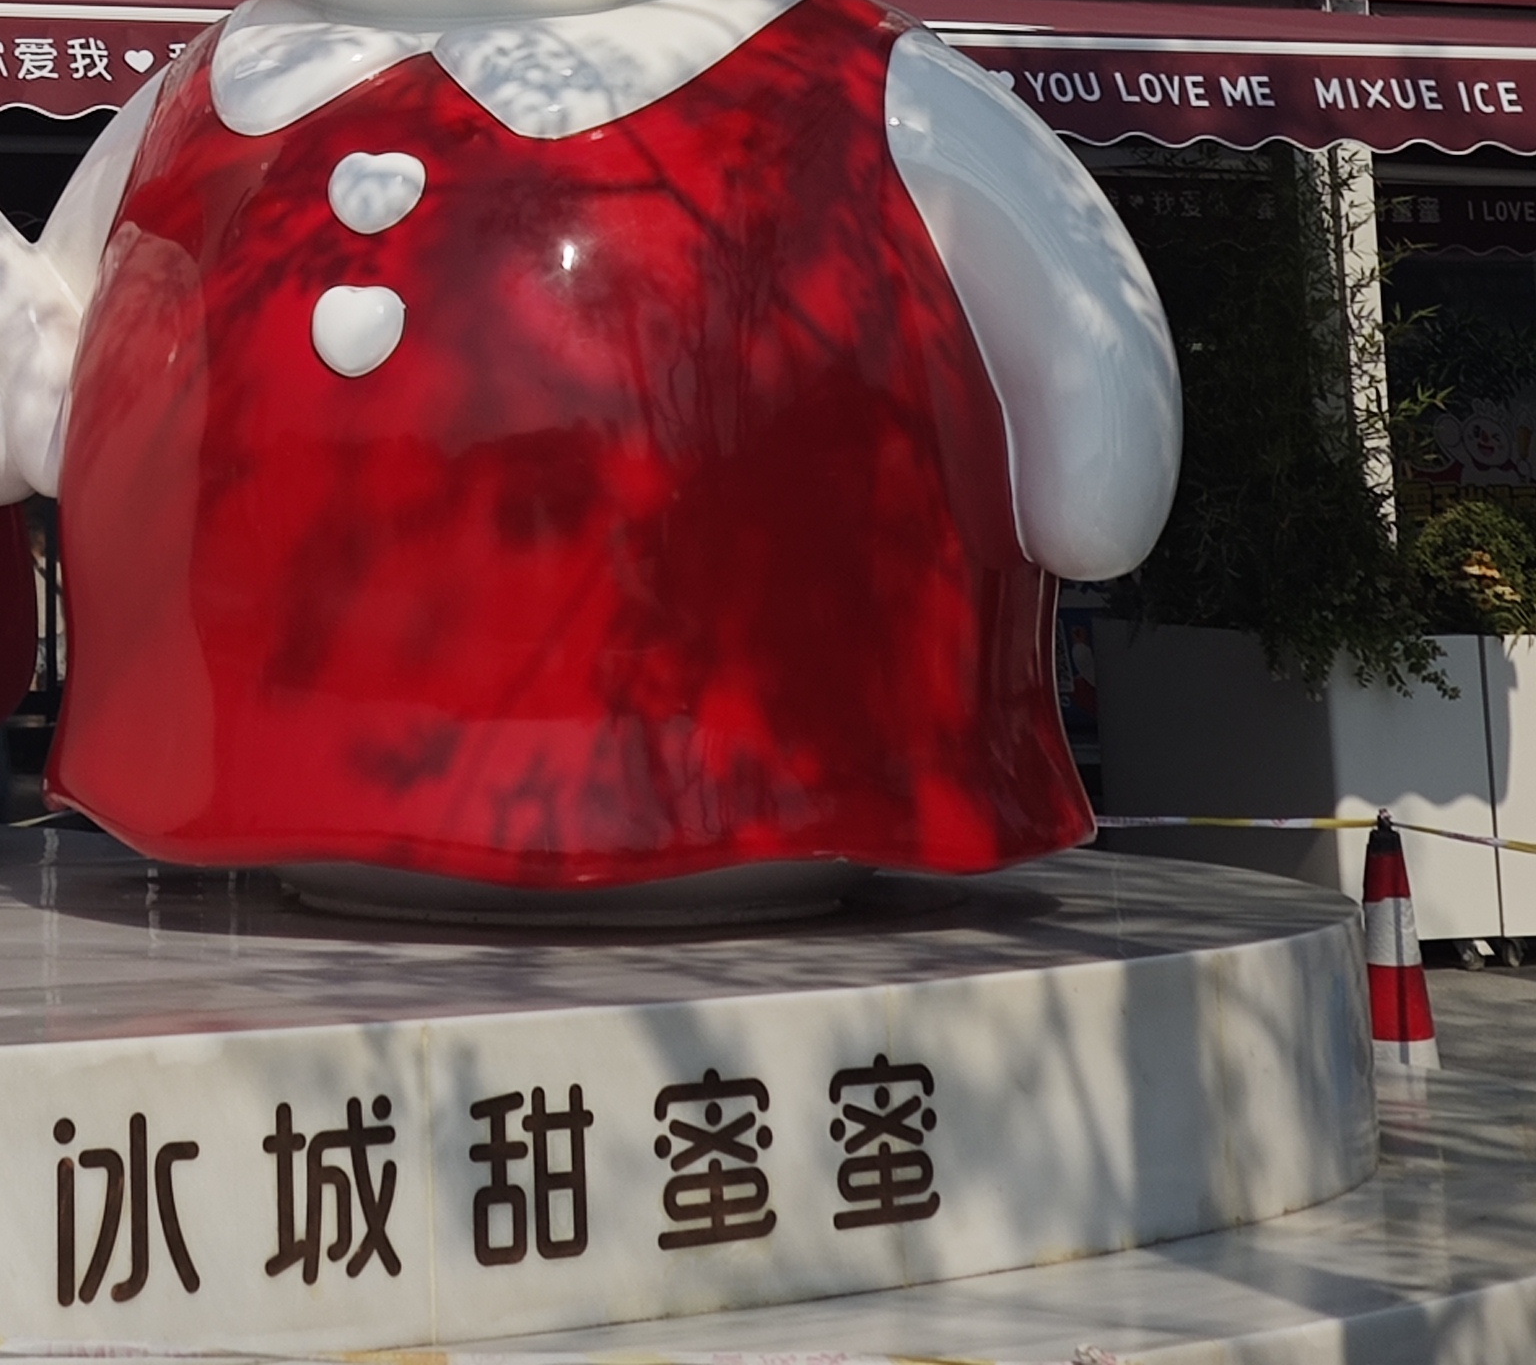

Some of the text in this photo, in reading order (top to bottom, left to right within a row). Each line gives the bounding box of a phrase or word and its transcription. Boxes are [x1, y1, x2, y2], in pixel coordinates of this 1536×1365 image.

[1023, 70, 1524, 115] YOU LOVE ME MIXUE ICE
